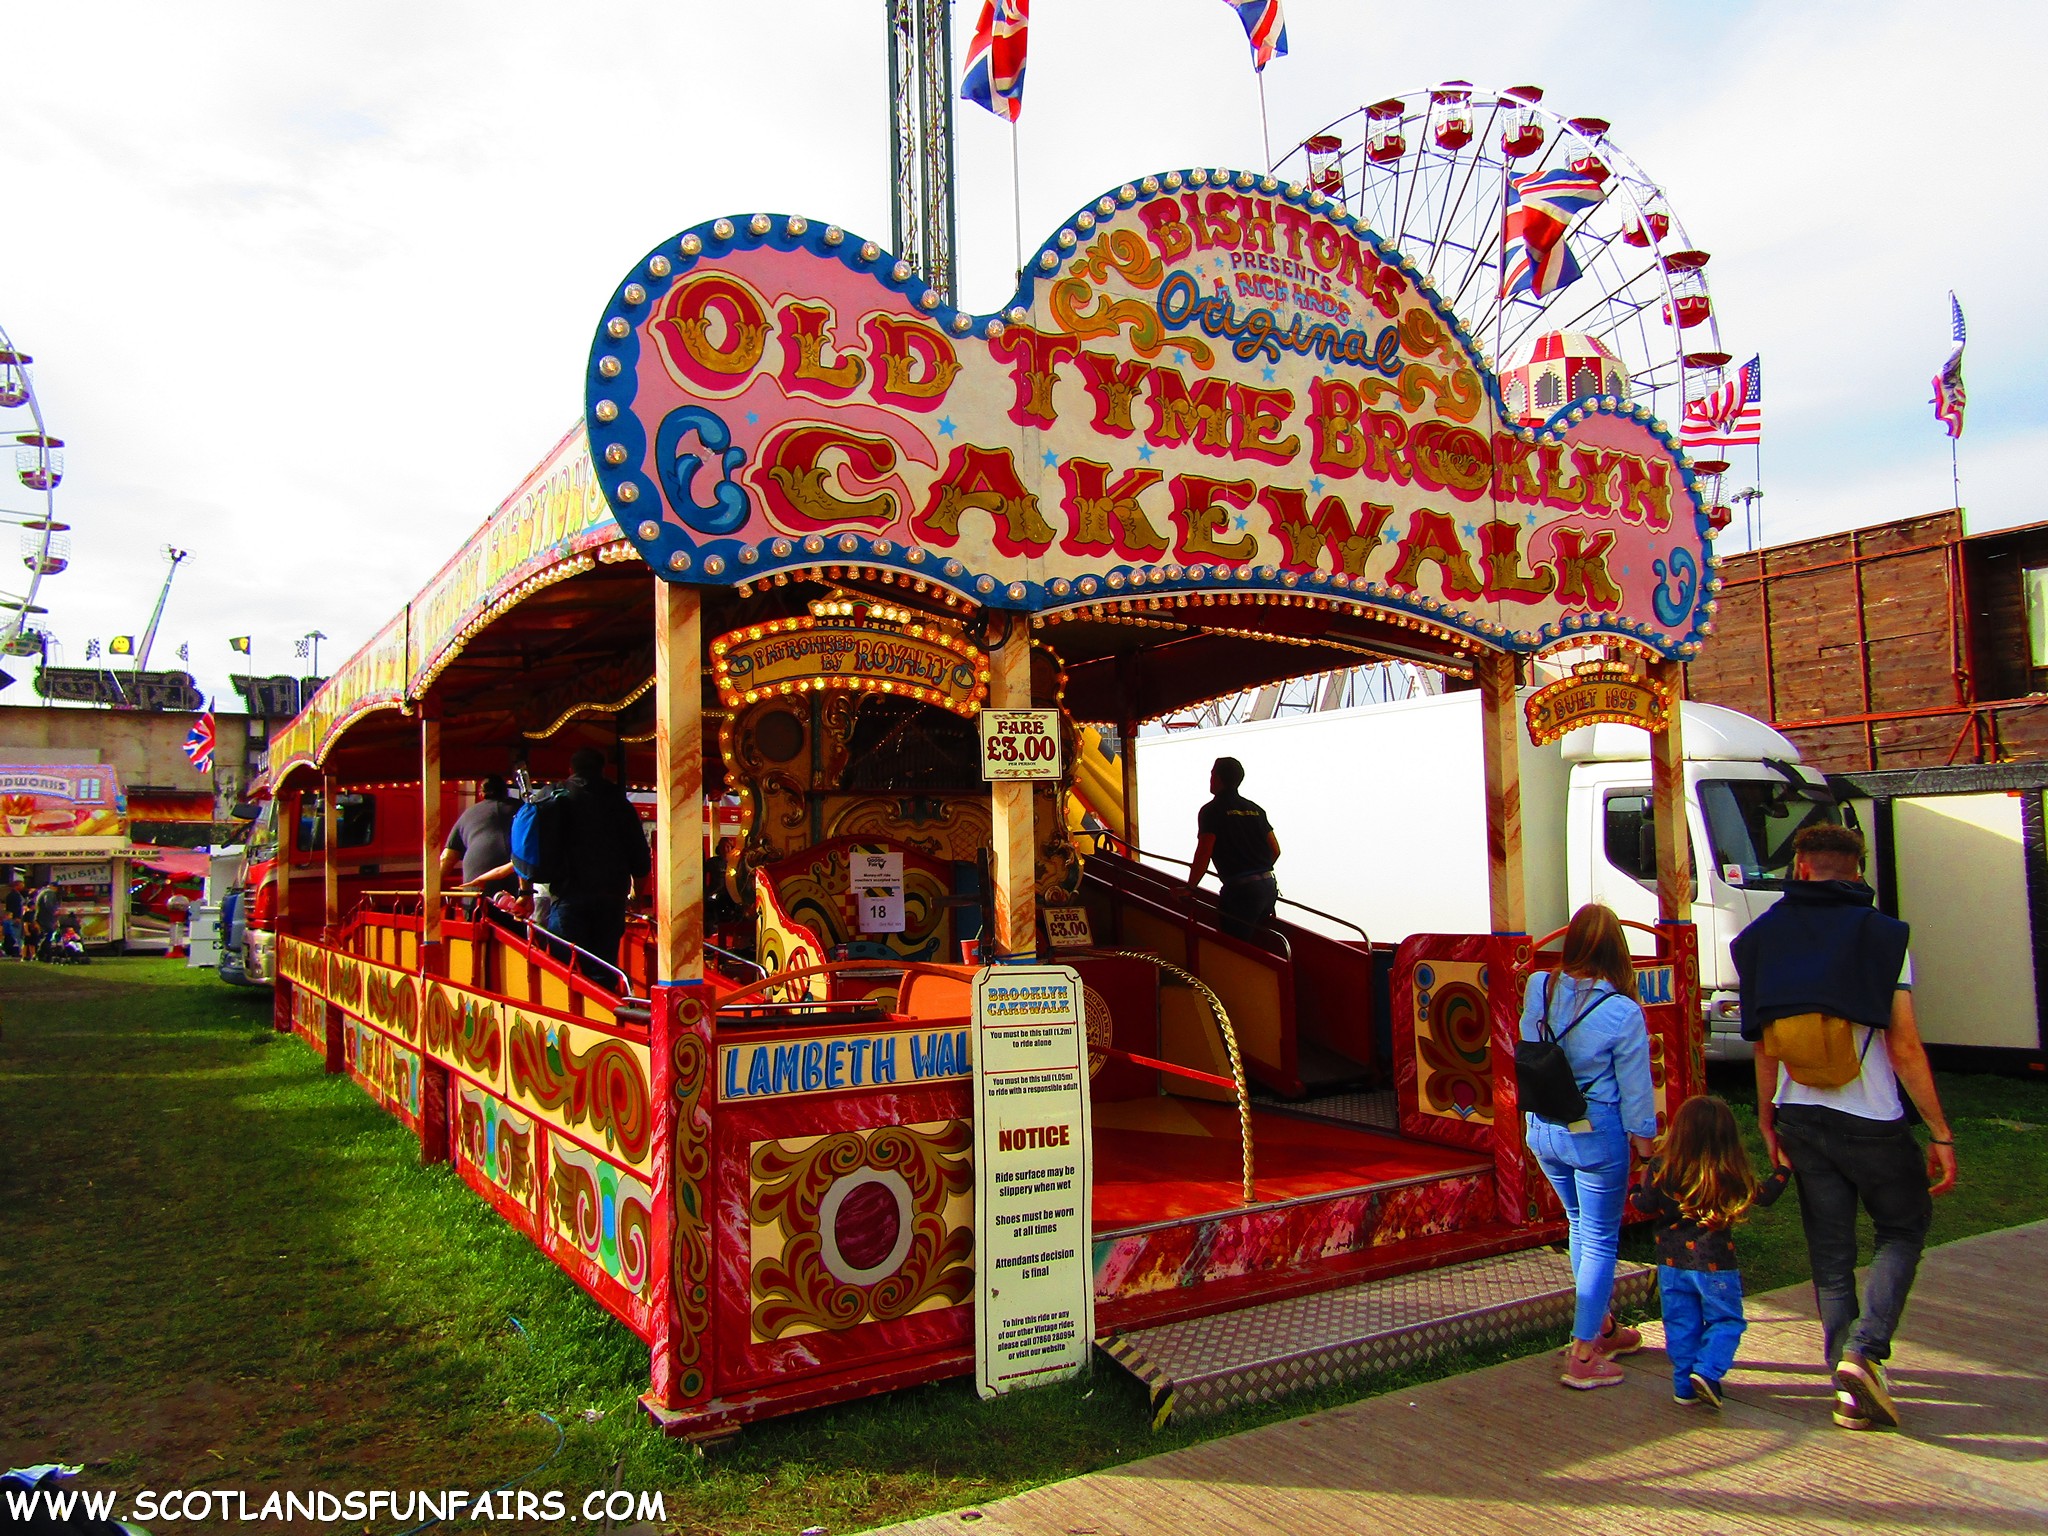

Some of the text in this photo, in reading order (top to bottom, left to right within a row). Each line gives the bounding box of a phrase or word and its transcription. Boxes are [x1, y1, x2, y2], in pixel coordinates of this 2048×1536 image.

[1230, 251, 1332, 292] PRESENTS
[1157, 270, 1405, 378] Original
[655, 276, 1673, 529] OLD TYME BROOKLYN
[756, 427, 1624, 613] CAKEWALK
[754, 634, 954, 686] PATRONISED BY ROYALTY
[1553, 688, 1598, 720] BUILT
[997, 721, 1045, 735] FARE
[987, 735, 1056, 762] £3.00
[56, 866, 106, 882] MUSHY
[870, 905, 886, 918] 18
[1053, 913, 1079, 921] FARE
[1050, 921, 1087, 936] £3.00
[988, 986, 1068, 1001] BROOKLYN
[1637, 967, 1673, 1004] ALK
[987, 1000, 1070, 1016] CAKEWALK
[990, 1031, 1002, 1039] You
[1003, 1030, 1019, 1038] must
[1029, 1029, 1042, 1037] this
[1042, 1028, 1053, 1036] tall
[1034, 1039, 1052, 1047] alone
[725, 1031, 973, 1099] LAMBETH WAL
[1005, 1077, 1020, 1085] must
[1029, 1075, 1041, 1083] this
[1041, 1074, 1051, 1082] tall
[1009, 1086, 1022, 1095] with
[1027, 1083, 1062, 1093] responsible
[1063, 1082, 1078, 1091] adult
[998, 1125, 1070, 1152] NOTICE
[995, 1166, 1075, 1183] Ride surface may be
[999, 1180, 1071, 1197] slippery when wet
[995, 1207, 1074, 1226] Shoes must be worn
[1013, 1223, 1057, 1238] at all times
[995, 1249, 1074, 1269] Attendants decision
[1022, 1266, 1049, 1279] is final
[1003, 1310, 1069, 1328] To hire this ride or any
[998, 1320, 1074, 1340] of our other Vintage rides
[997, 1342, 1019, 1352] please
[1020, 1337, 1031, 1347] call
[1008, 1343, 1066, 1360] or visit our website
